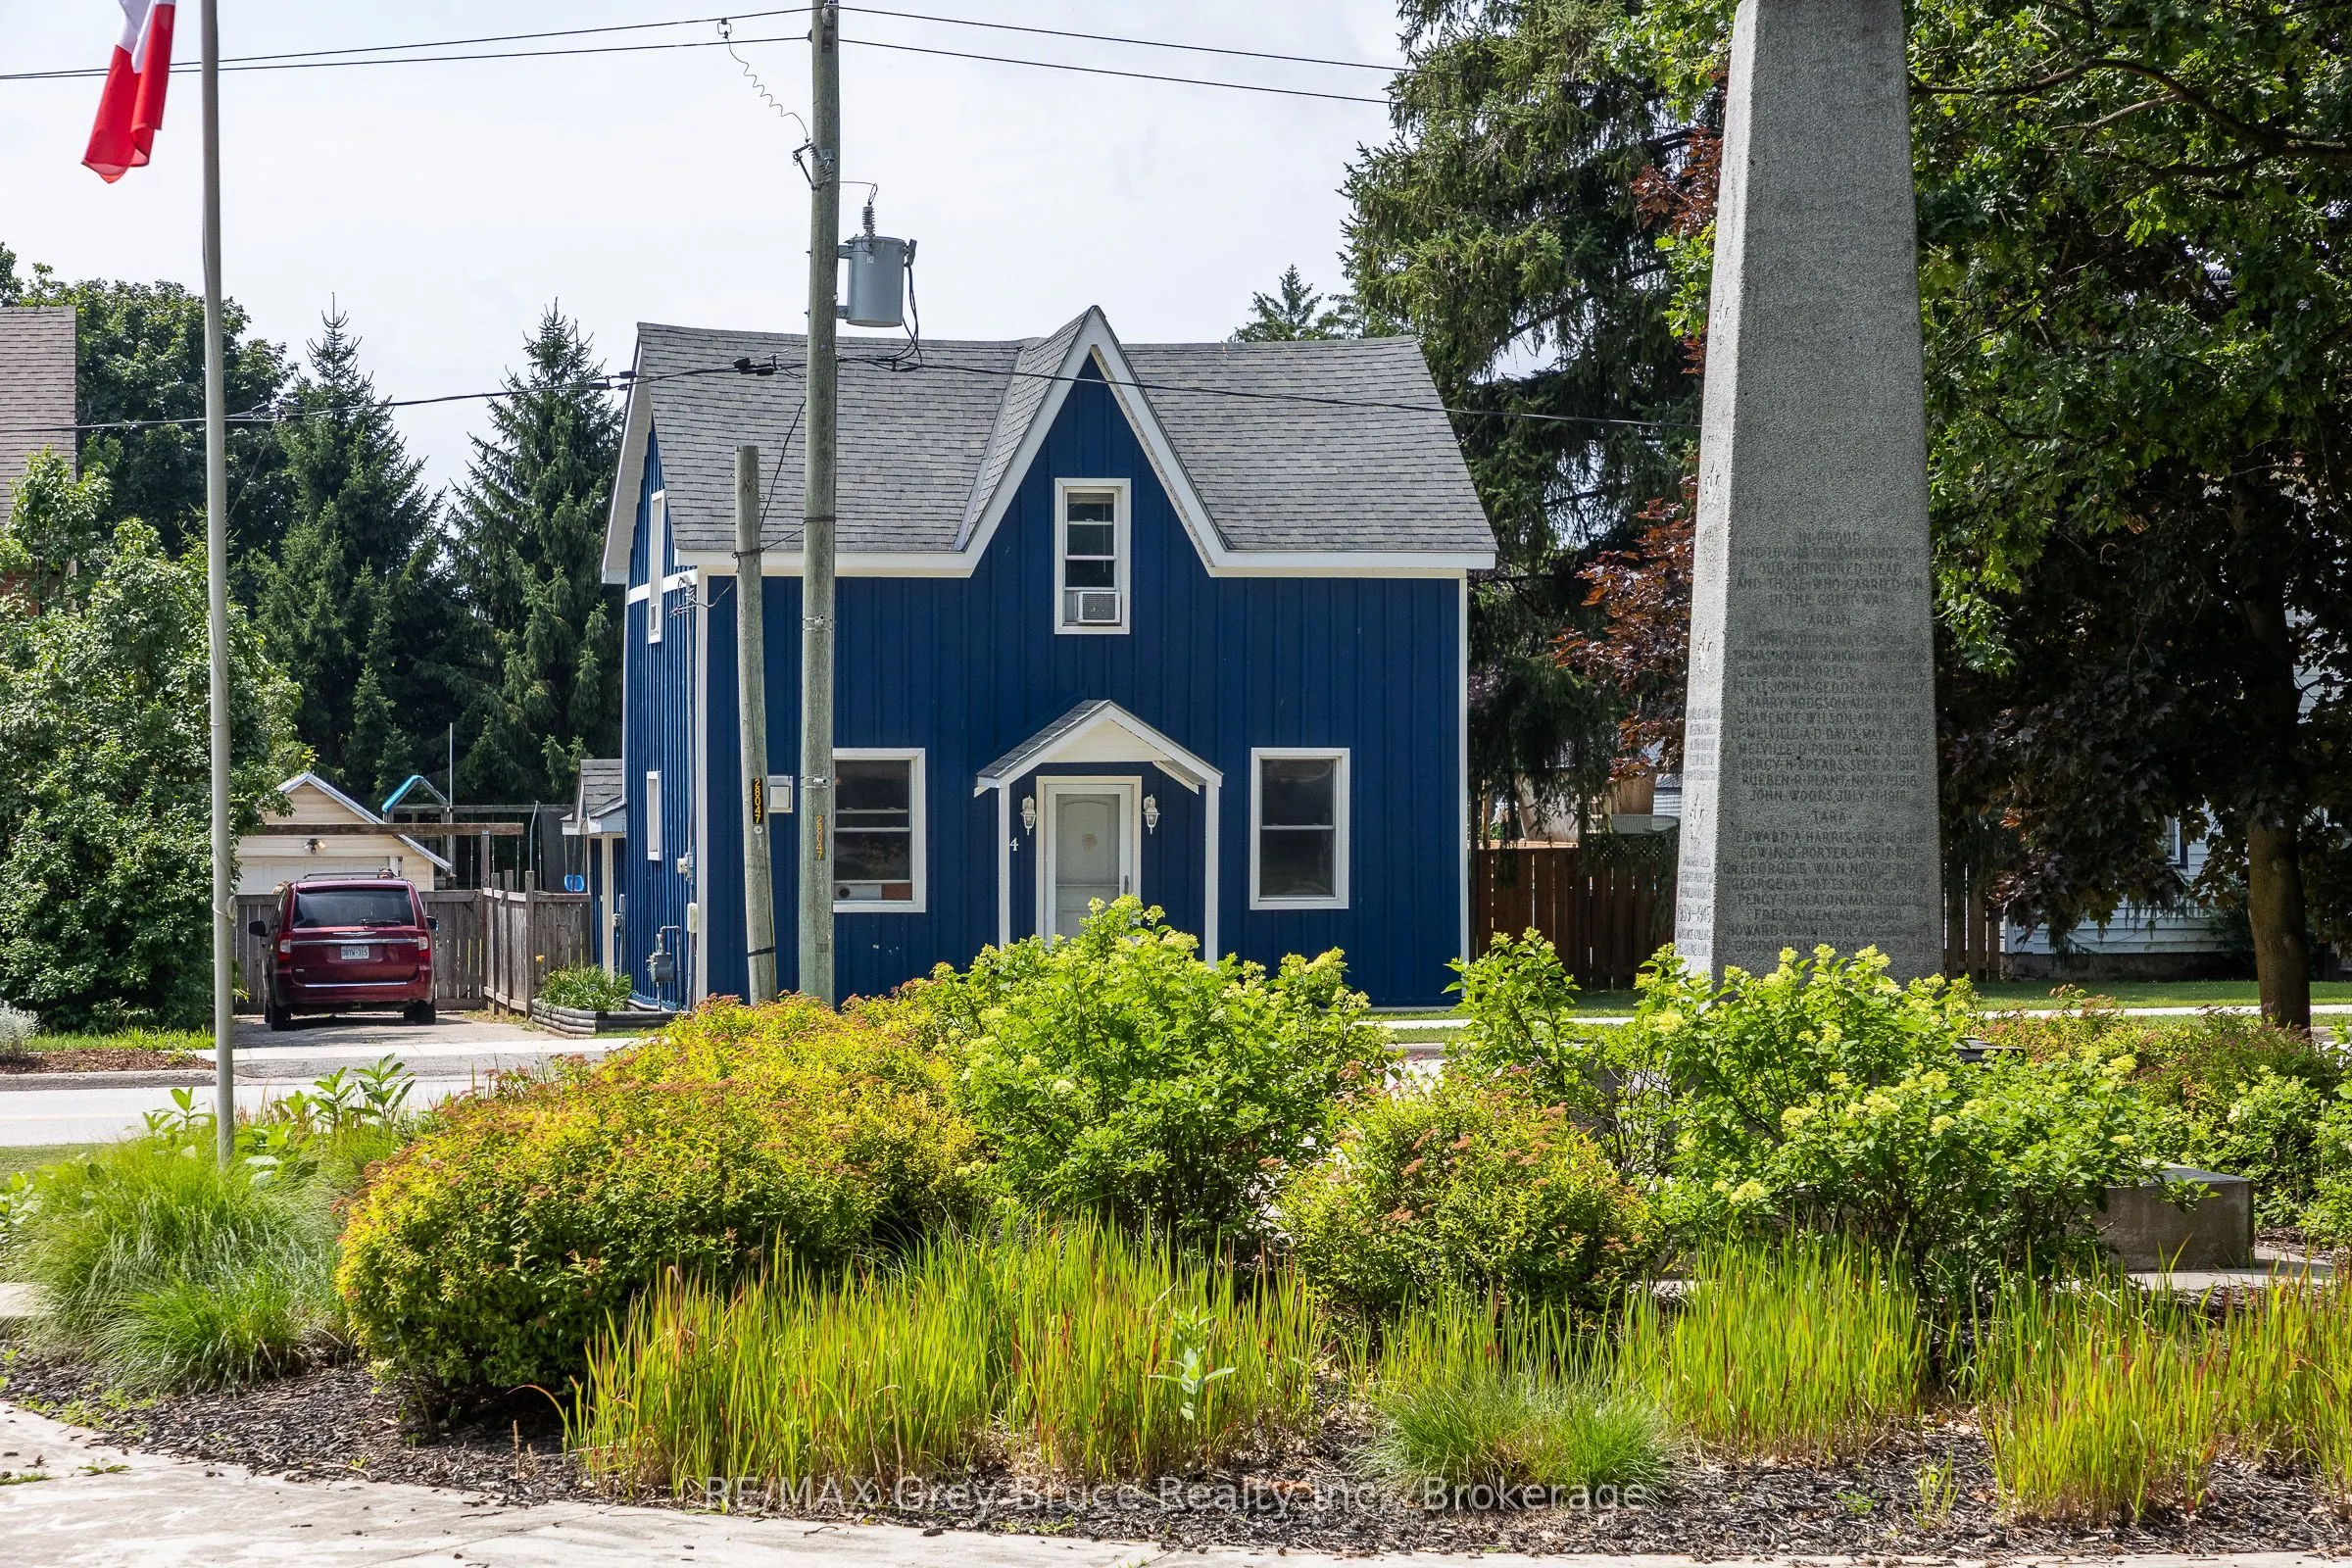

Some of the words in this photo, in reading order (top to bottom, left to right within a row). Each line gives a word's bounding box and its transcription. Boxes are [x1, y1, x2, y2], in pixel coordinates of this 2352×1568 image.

[866, 255, 875, 264] H2
[1817, 532, 1861, 544] PROUD
[1870, 562, 1902, 575] DEAD
[1736, 577, 1760, 590] AND
[1769, 577, 1805, 590] THOSE
[1741, 759, 1781, 771] PERCY
[1749, 790, 1783, 803] JOHN
[1813, 811, 1847, 824] TARA
[1737, 831, 1788, 844] EDWARD
[1009, 838, 1019, 852] 4
[1740, 847, 1782, 859] EDWIN
[1742, 861, 1793, 874] GEORGE
[1731, 879, 1783, 891] GEORGE
[1738, 894, 1778, 906] PERCY
